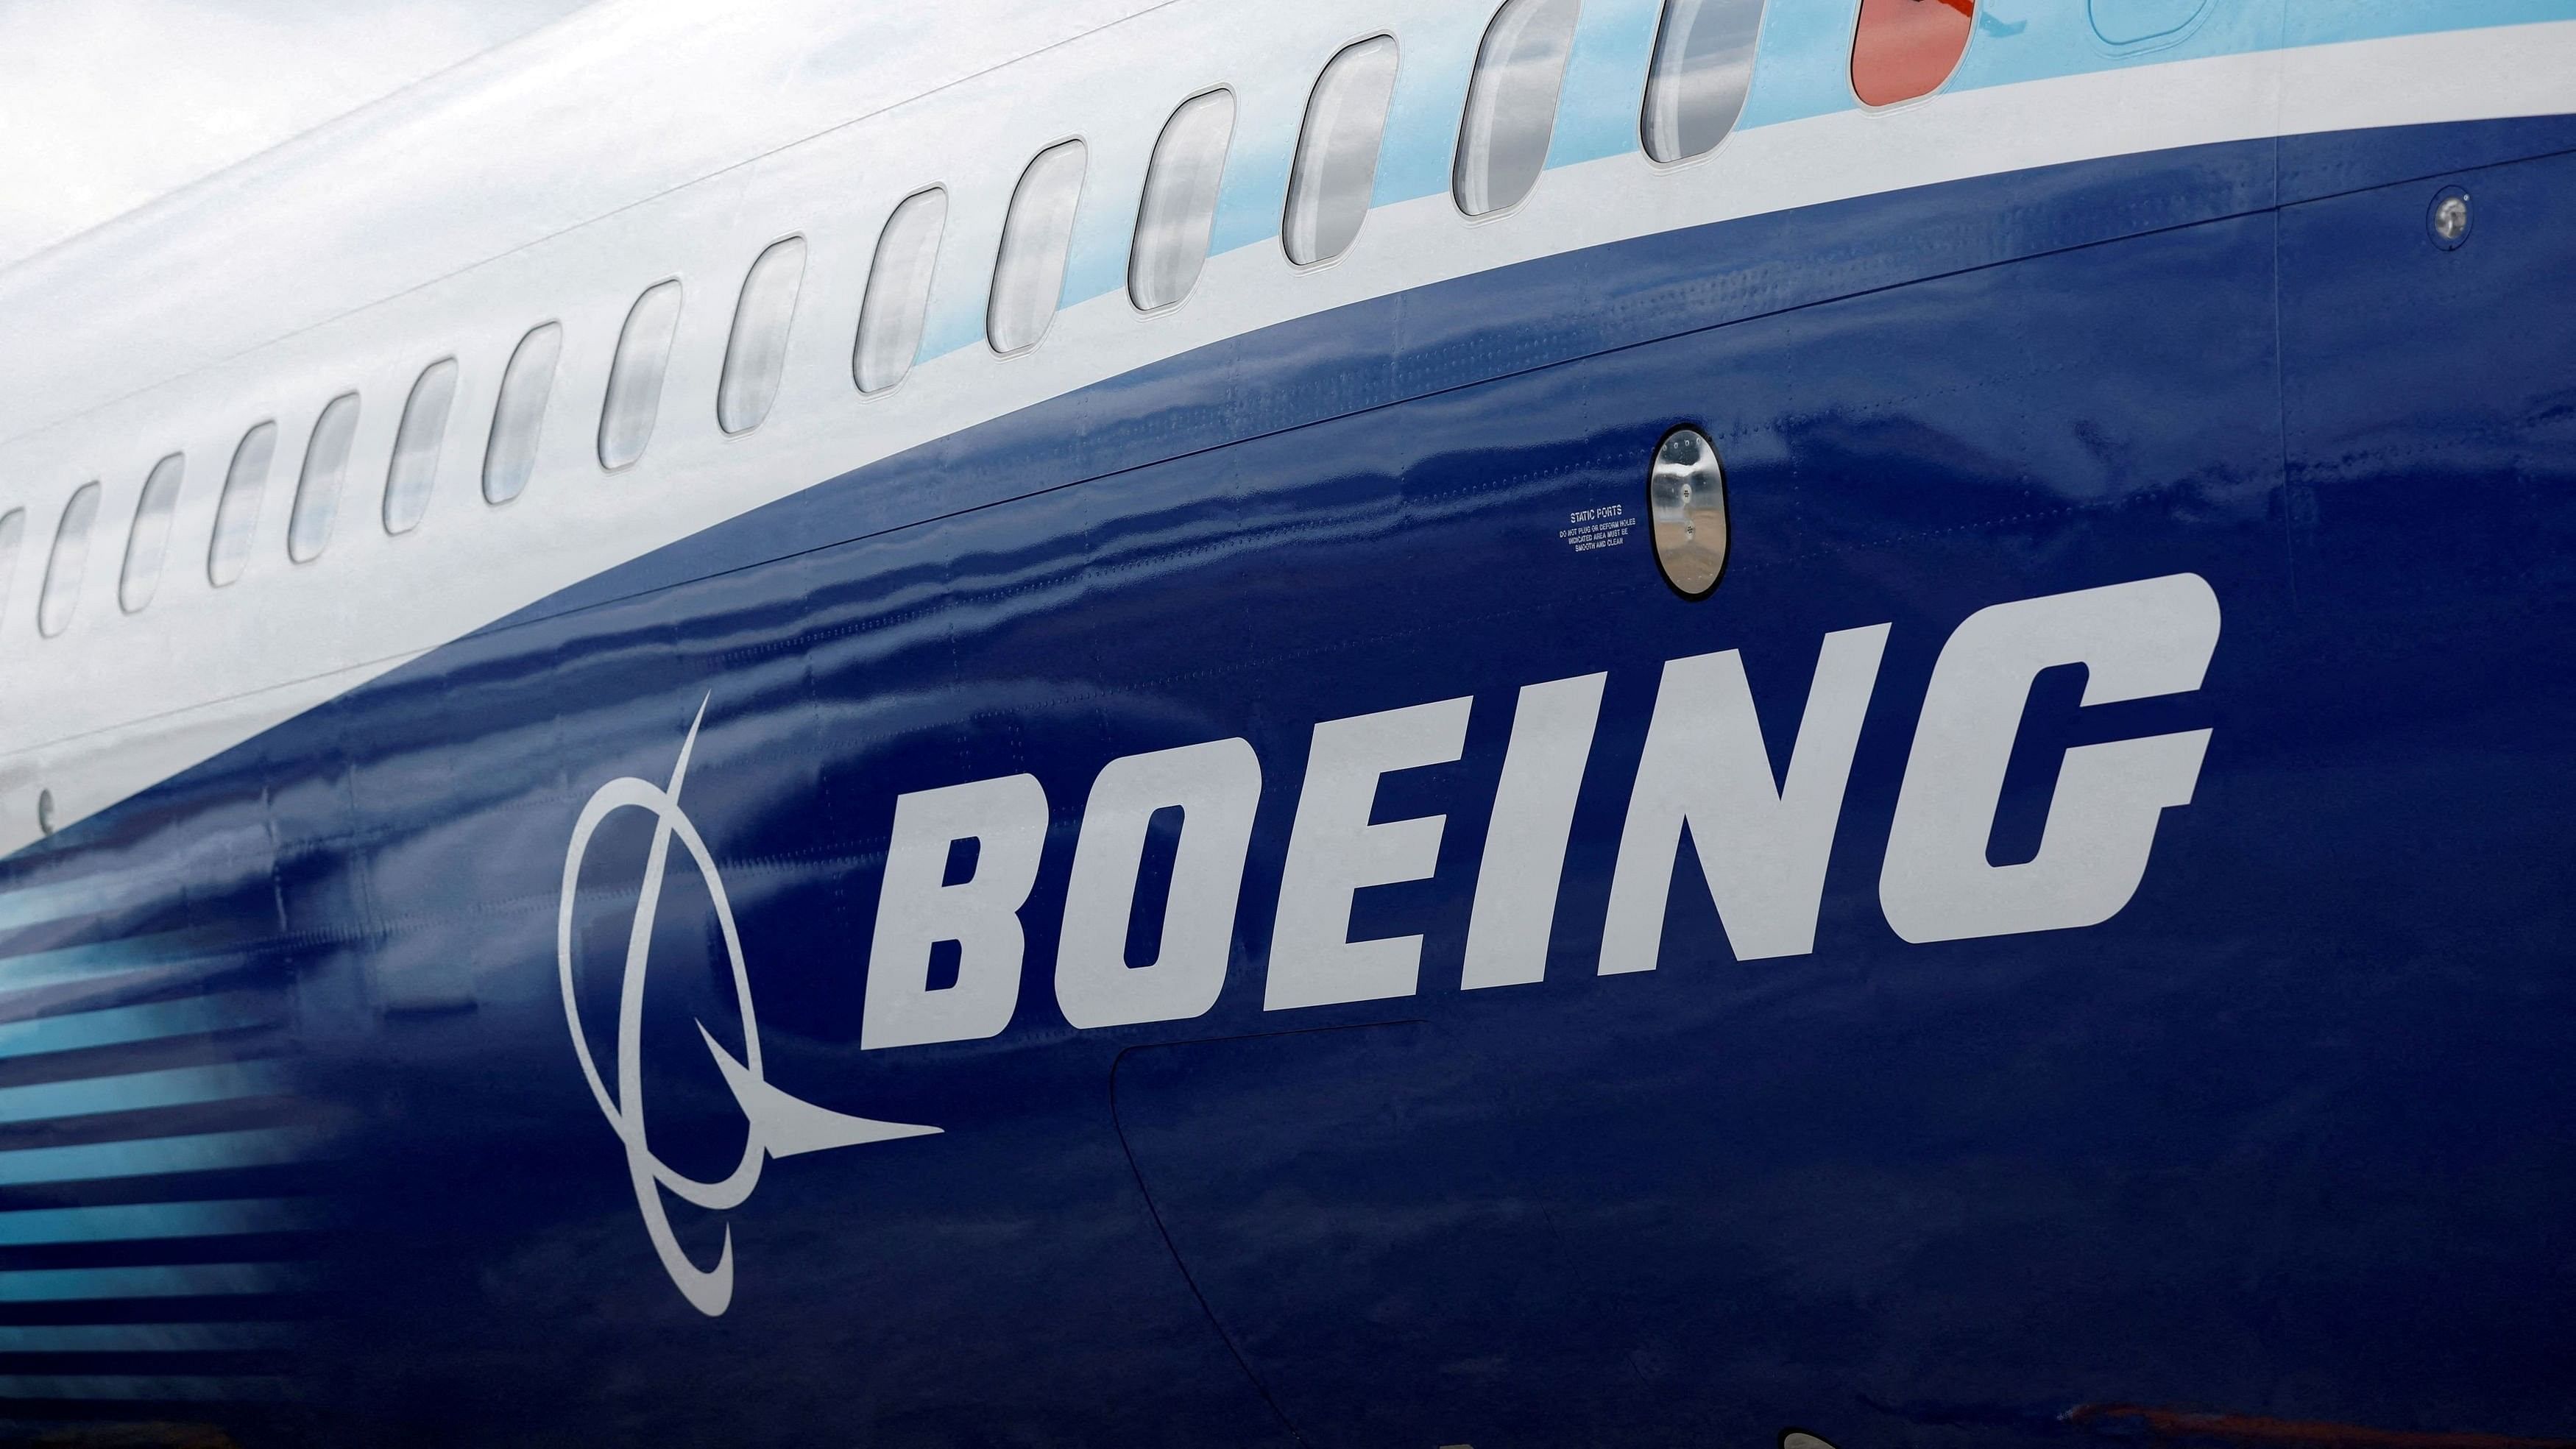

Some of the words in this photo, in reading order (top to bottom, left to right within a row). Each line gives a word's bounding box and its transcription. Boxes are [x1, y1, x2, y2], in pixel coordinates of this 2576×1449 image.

[1571, 509, 1594, 523] STATIC
[1597, 504, 1621, 518] PORTS
[1568, 528, 1577, 536] NOT
[1579, 526, 1590, 534] PLUG
[1599, 522, 1619, 531] DEFORM
[1620, 518, 1635, 527] HOLES
[1568, 535, 1592, 545] INDICATED
[1575, 542, 1595, 552] SMOOTH
[1607, 538, 1623, 546] CLEAN
[861, 573, 2221, 1049] BOEING
